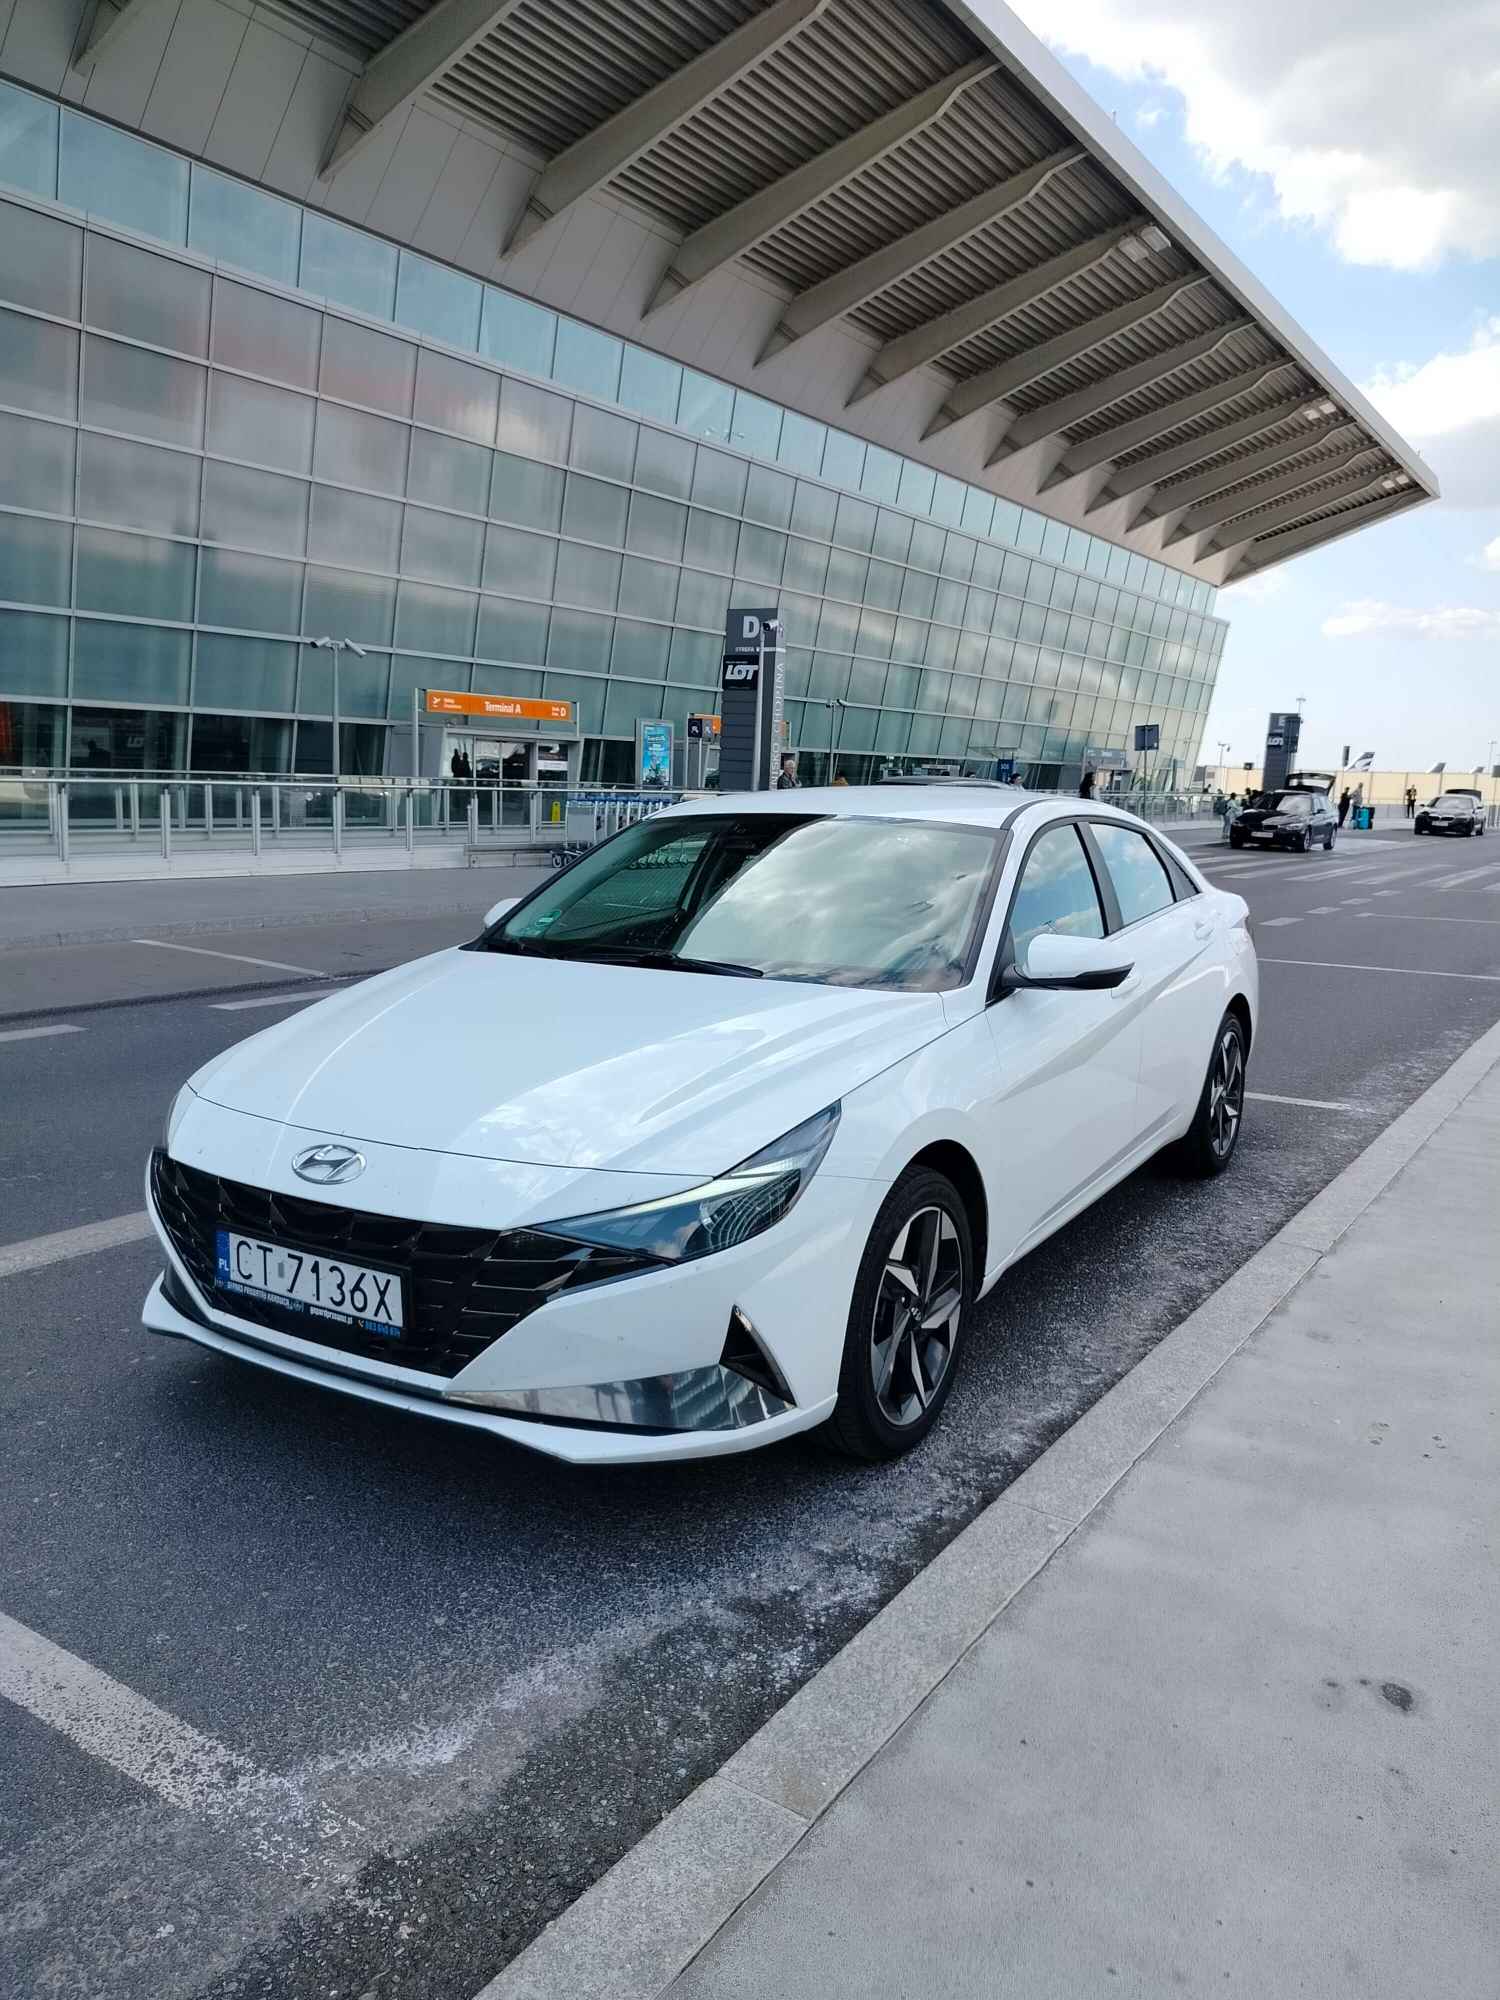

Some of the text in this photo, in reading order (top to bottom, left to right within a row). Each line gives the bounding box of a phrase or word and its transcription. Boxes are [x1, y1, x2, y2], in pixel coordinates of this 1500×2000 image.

[743, 615, 760, 638] D
[725, 664, 760, 680] LOT
[484, 701, 522, 714] Terminal A
[218, 1258, 229, 1272] PL
[236, 1240, 274, 1286] CT
[287, 1252, 393, 1321] 7136X
